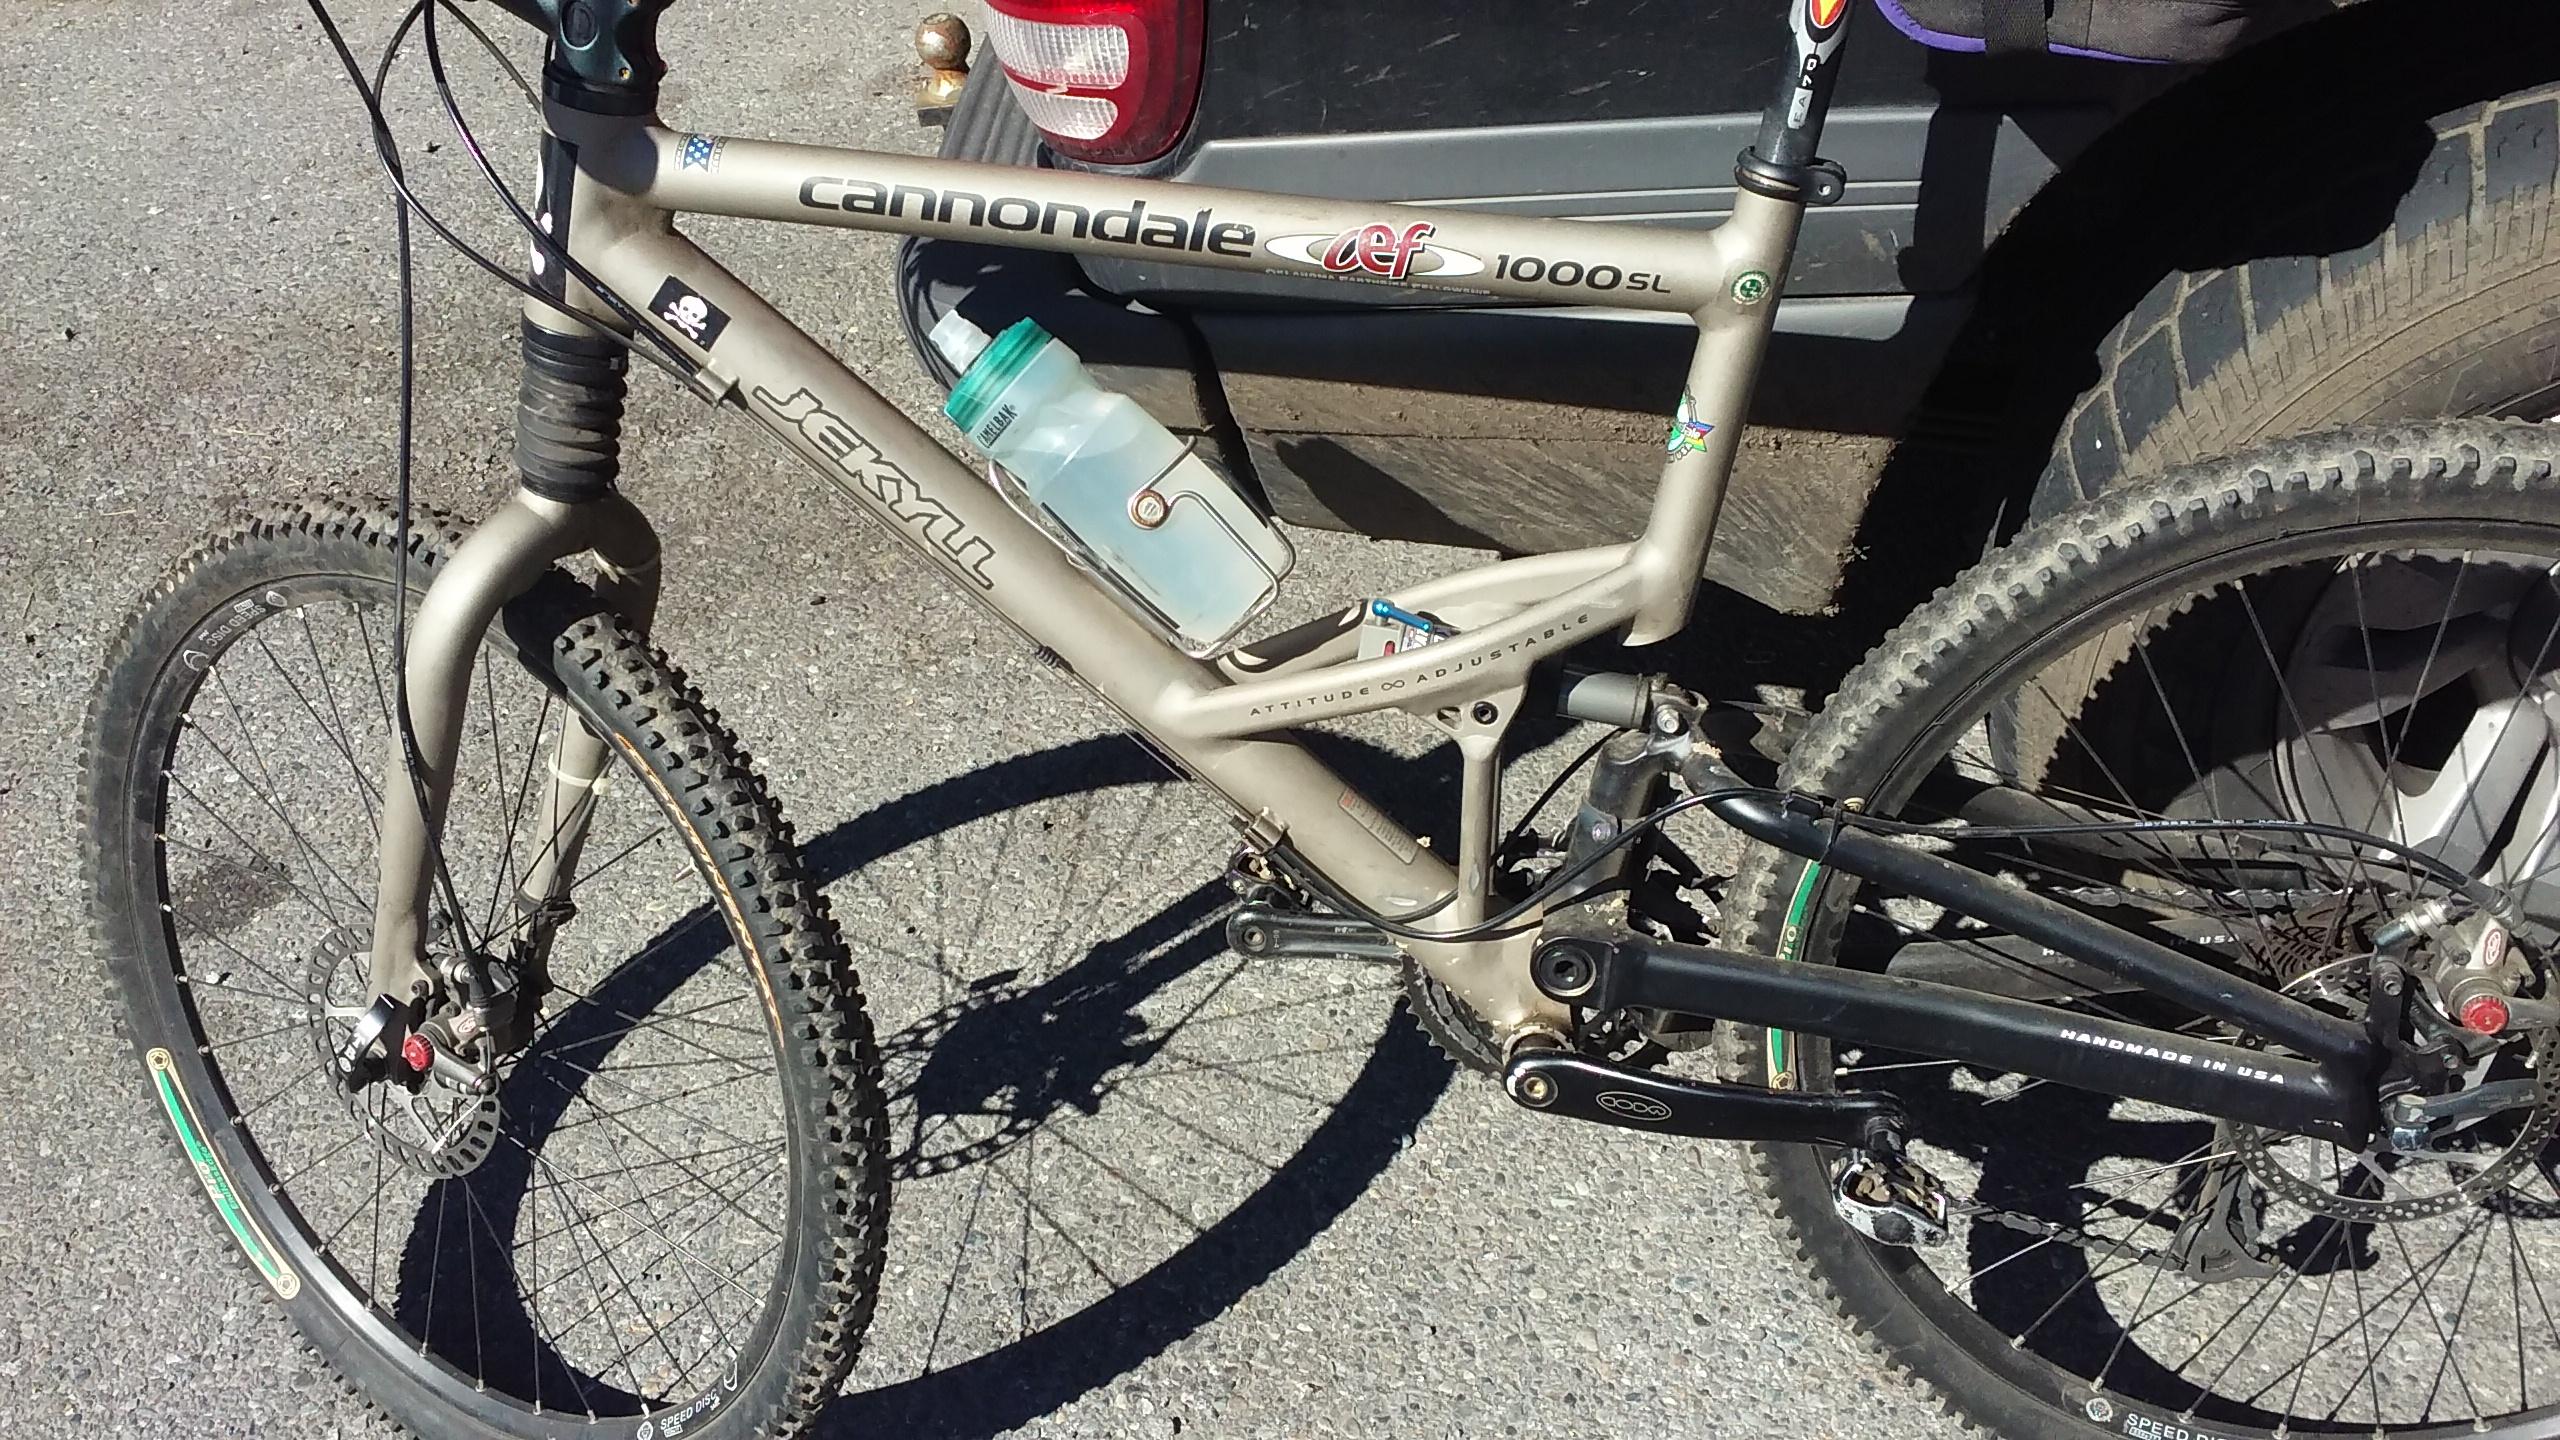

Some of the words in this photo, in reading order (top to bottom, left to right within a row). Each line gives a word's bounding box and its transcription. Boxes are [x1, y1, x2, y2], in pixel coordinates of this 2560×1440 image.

[798, 175, 1256, 259] cannondale
[751, 384, 997, 590] JEKYLL
[1249, 686, 1371, 716] ATTITUDE
[1416, 612, 1589, 684] ADJUSTABLE
[2060, 1029, 2194, 1065] HANDMADE
[2203, 1058, 2228, 1073] IN
[2237, 1066, 2286, 1085] USA
[660, 1406, 694, 1431] SPEED
[695, 1387, 718, 1413] DISC
[2126, 1413, 2190, 1440] SPEED
